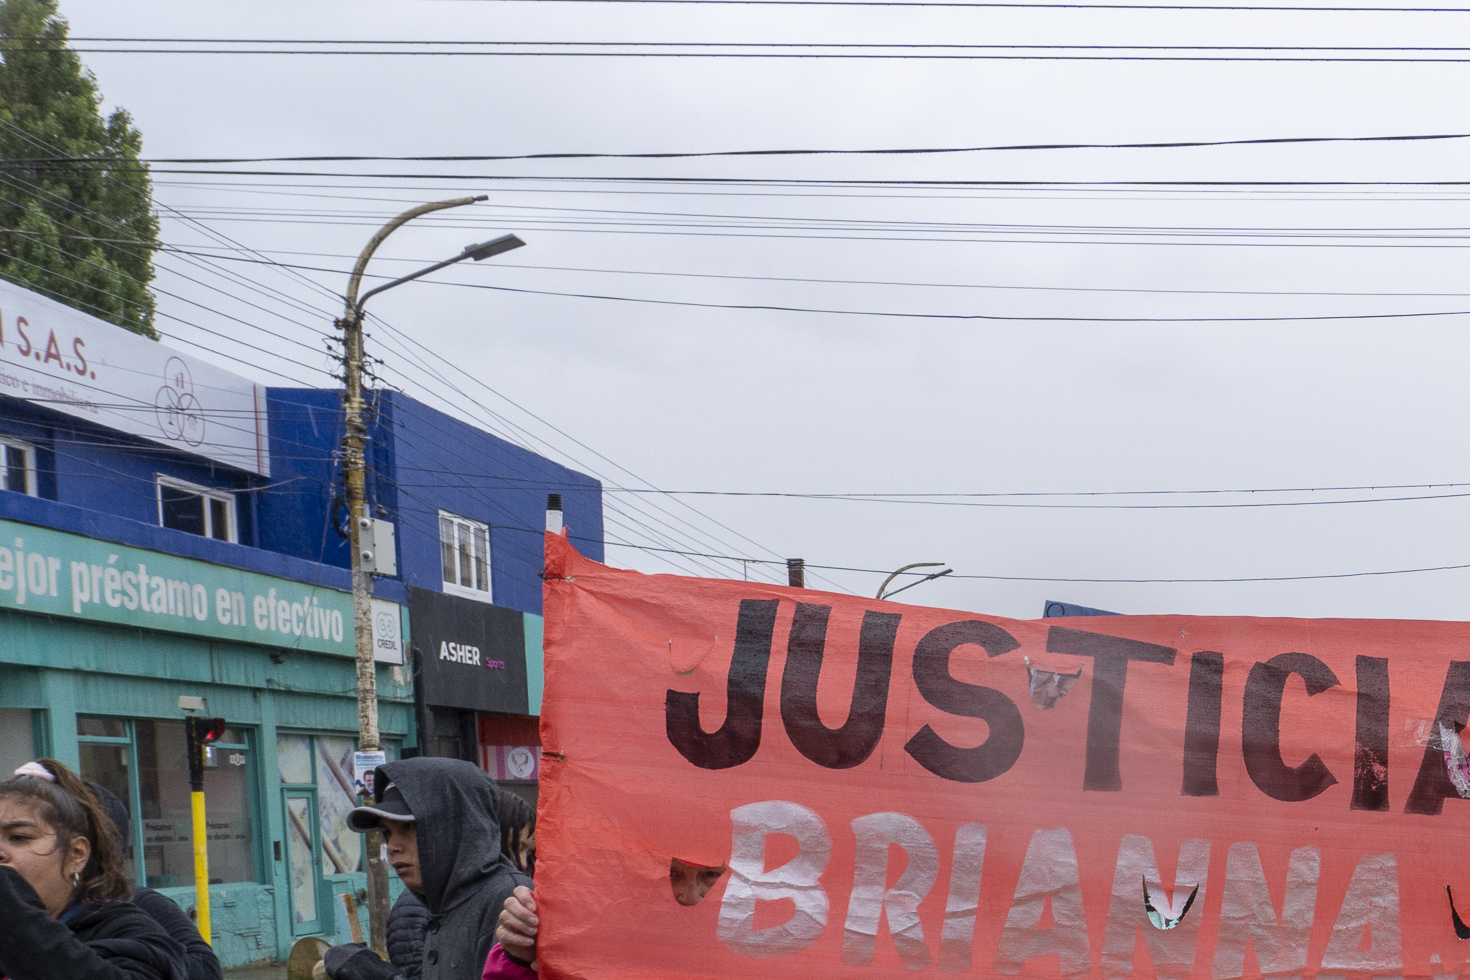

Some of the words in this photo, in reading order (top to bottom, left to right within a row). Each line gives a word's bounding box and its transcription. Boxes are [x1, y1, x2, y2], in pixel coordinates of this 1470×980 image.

[16, 315, 97, 381] S.A.S.
[70, 554, 208, 622] préstamo
[215, 588, 247, 627] en
[253, 587, 344, 643] efectivo
[440, 640, 480, 666] ASHER
